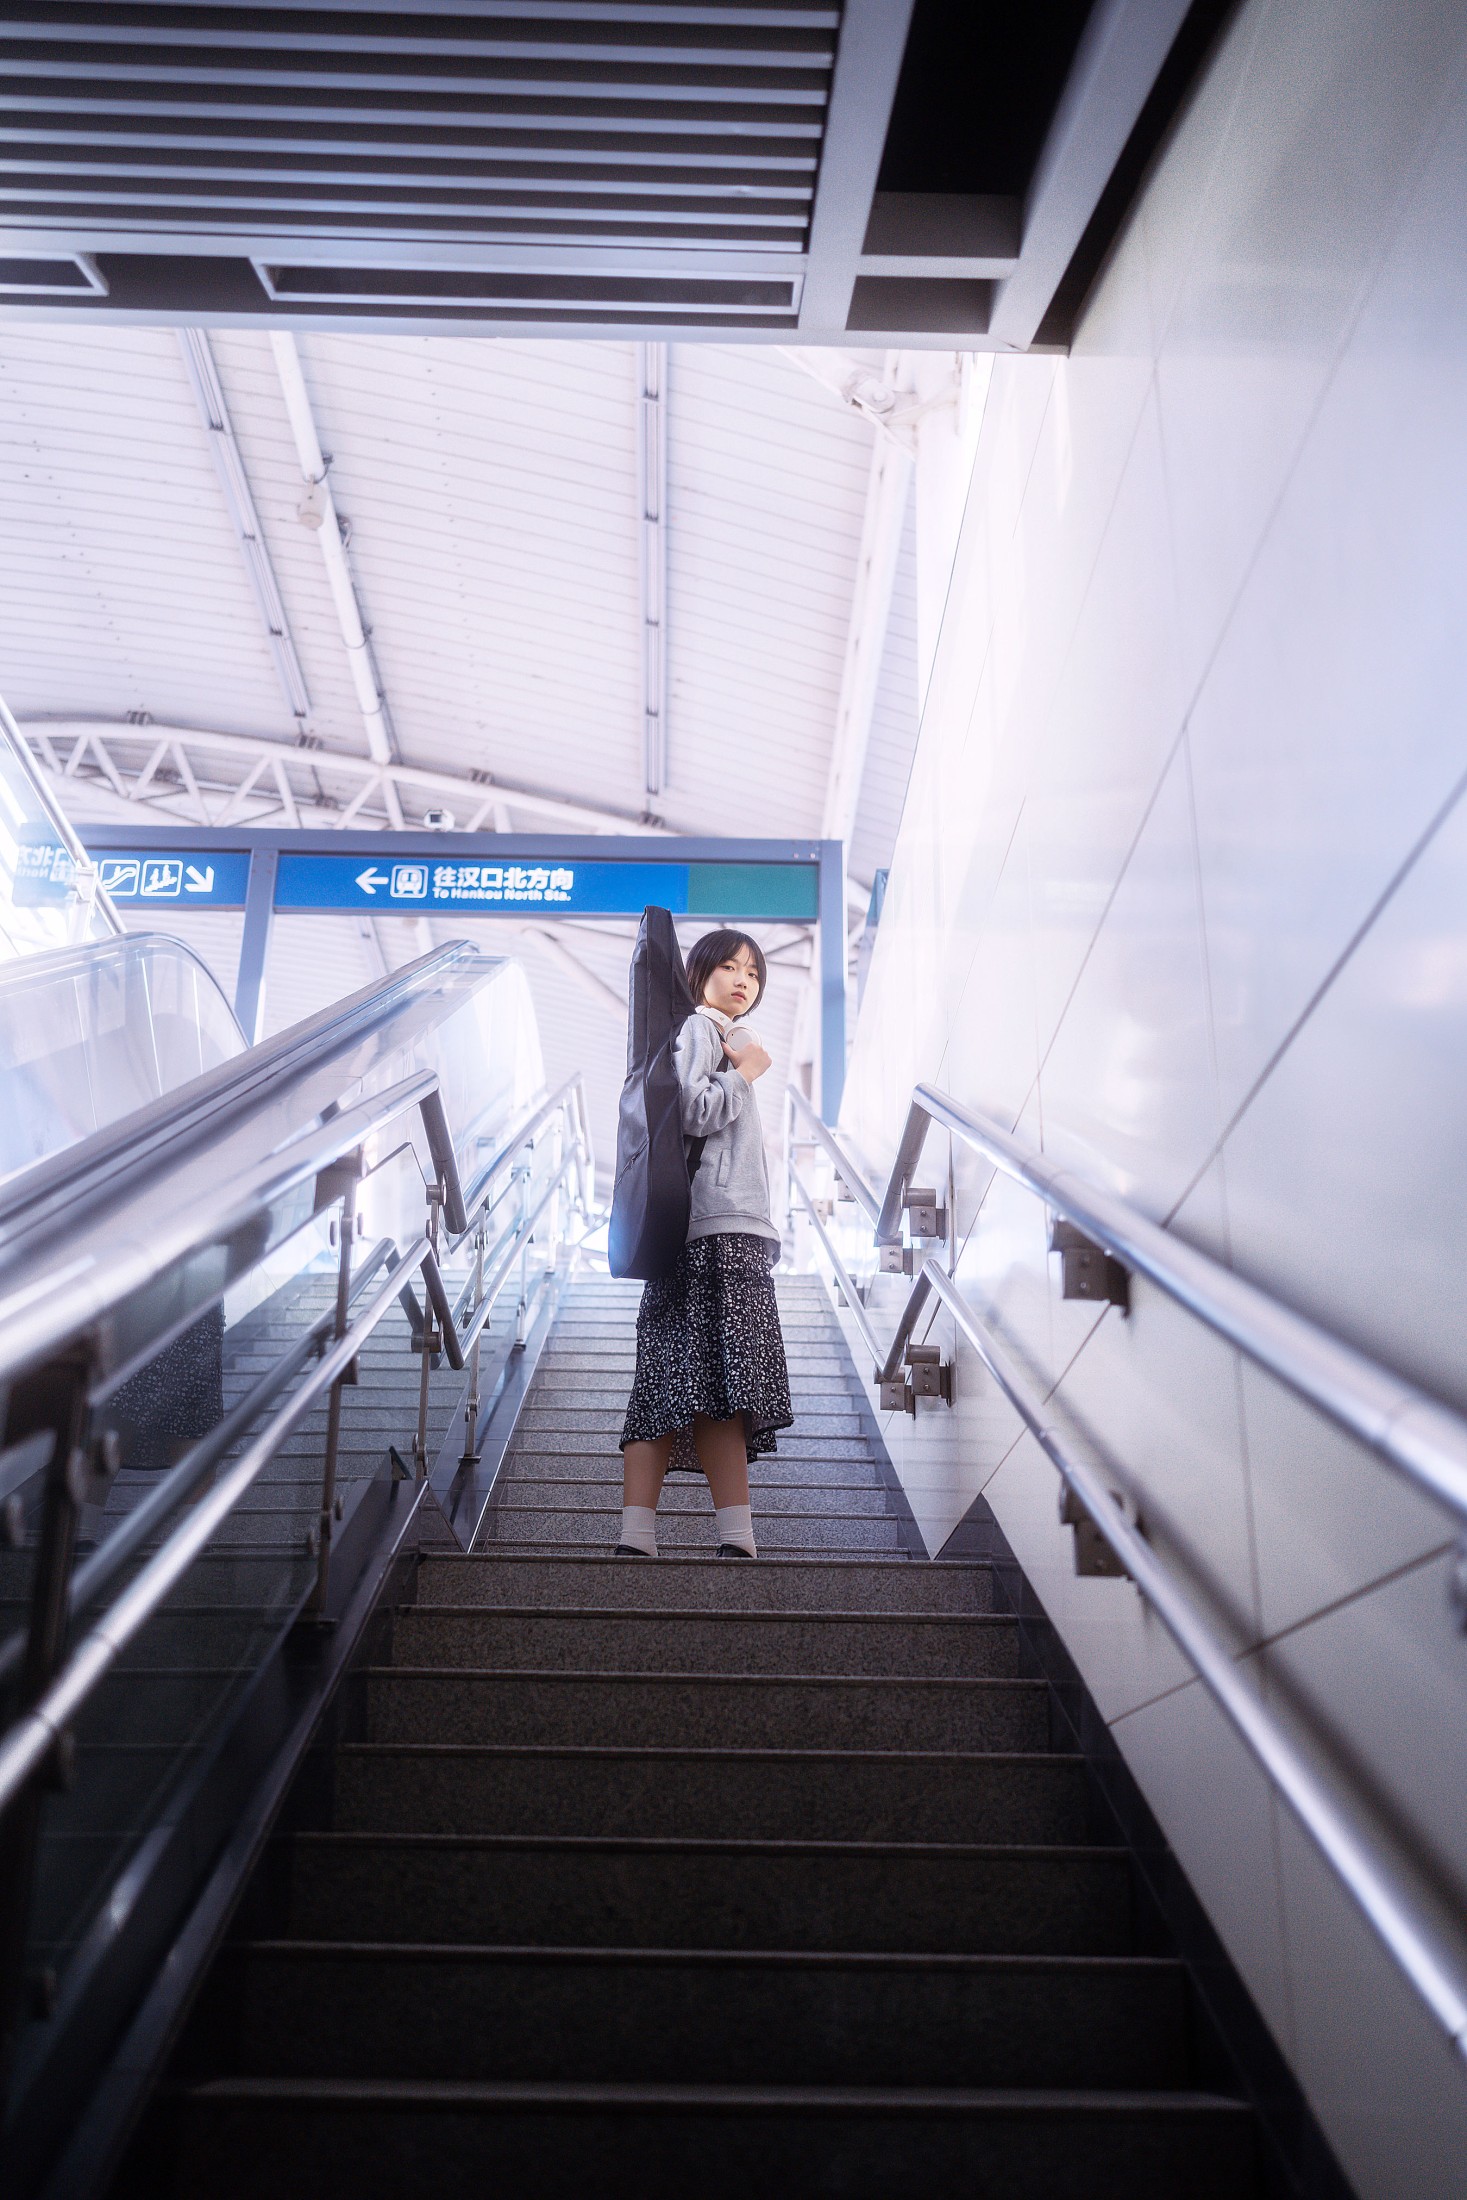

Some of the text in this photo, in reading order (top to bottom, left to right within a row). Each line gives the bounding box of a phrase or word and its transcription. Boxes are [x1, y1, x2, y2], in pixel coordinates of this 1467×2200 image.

[433, 866, 574, 890] 往汉口北方向
[432, 887, 572, 901] To Hankou North Sta.
